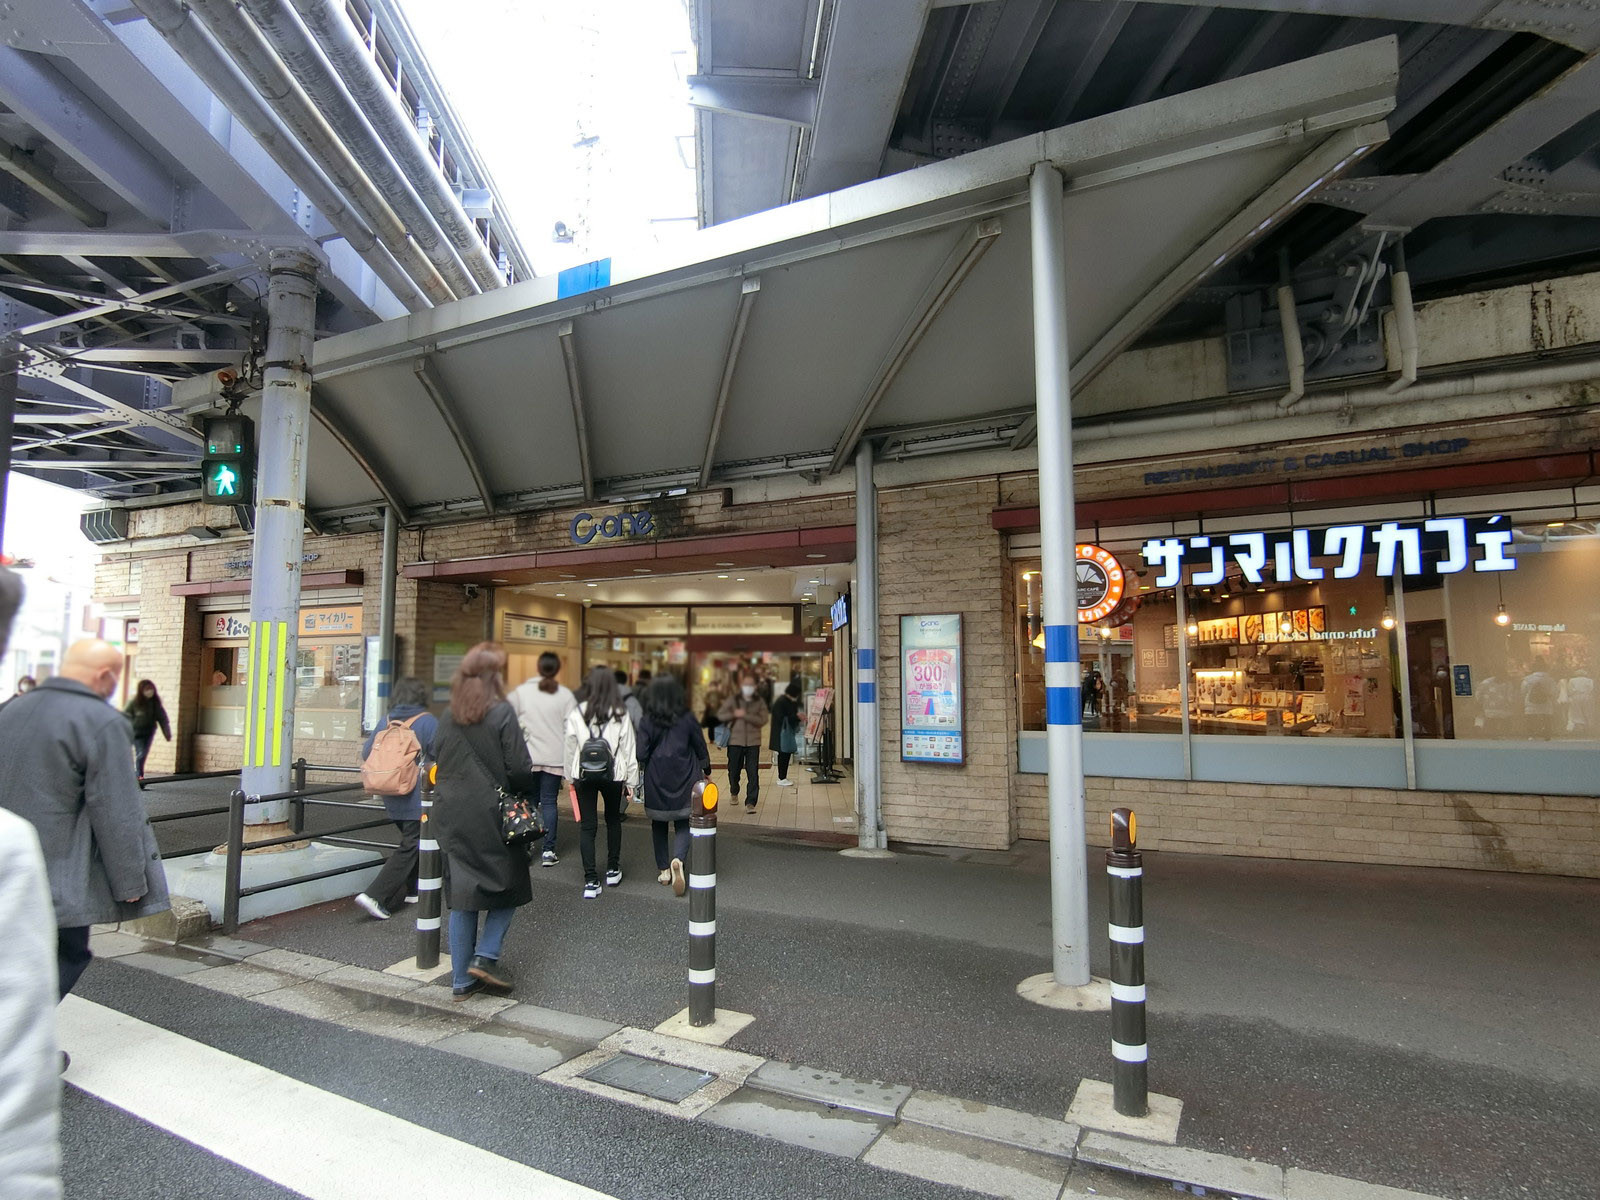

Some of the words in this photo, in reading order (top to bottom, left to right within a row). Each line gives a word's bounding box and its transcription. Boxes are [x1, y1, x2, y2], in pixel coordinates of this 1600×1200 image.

[1144, 458, 1275, 485] RESTAURANT
[1284, 457, 1298, 472] &
[1304, 446, 1396, 469] CASUAL
[1403, 437, 1470, 458] SHOP
[1142, 514, 1518, 588] サンマルクカフェ
[319, 612, 354, 623] マイカリー
[524, 623, 547, 638] お弁当
[914, 665, 942, 681] 300
